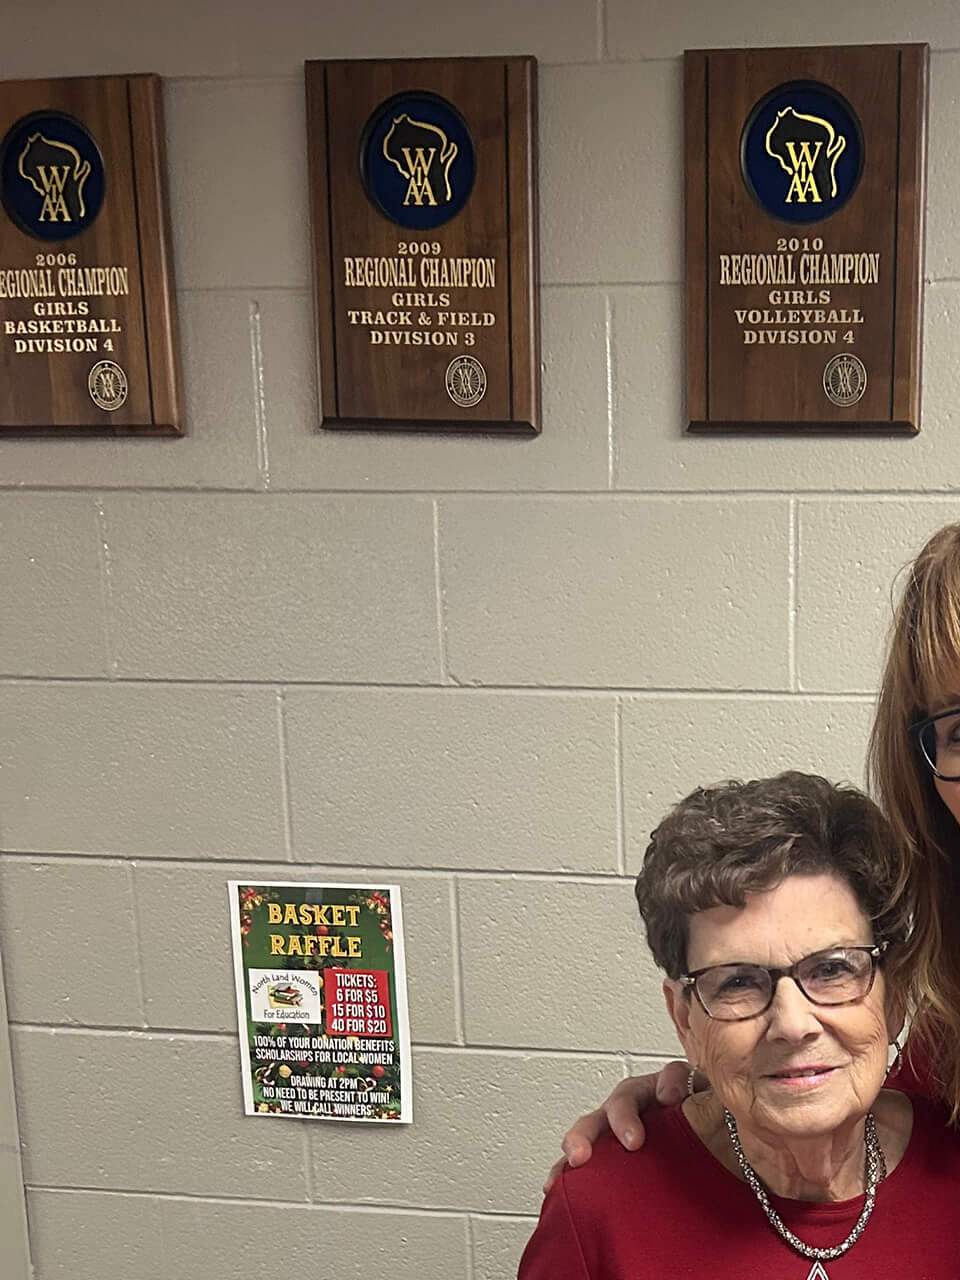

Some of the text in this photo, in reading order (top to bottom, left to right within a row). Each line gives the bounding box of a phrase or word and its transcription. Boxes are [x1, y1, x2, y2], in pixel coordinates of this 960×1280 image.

[398, 242, 441, 255] 2009
[777, 238, 824, 251] 2010
[36, 253, 77, 267] 2006
[344, 257, 496, 288] REGIONAL CHAMPION
[719, 253, 880, 285] REGIONAL CHAMPION
[0, 267, 129, 298] EGIONAL CHAMPION
[392, 293, 450, 307] GIRLS
[768, 290, 831, 305] GIRLS
[33, 301, 89, 316] GIRLS
[348, 311, 496, 326] TRACK & FIELD
[734, 309, 864, 324] VOLLEYBALL
[5, 319, 121, 334] BASKETBALL
[371, 331, 476, 346] DIVISION 3
[744, 330, 855, 345] DIVISION 4
[15, 338, 114, 353] DIVISION 4
[268, 903, 361, 927] BASKET
[270, 935, 362, 958] RAFFLE
[252, 973, 318, 996] North Land Women
[335, 974, 377, 988] TICKETS:
[336, 988, 378, 1003] 6 FOR $5
[264, 1009, 310, 1019] For Education
[332, 1004, 385, 1018] 15 FOR $10
[331, 1018, 387, 1033] 40 FOR $20
[253, 1036, 394, 1052] 100% OF YOUR DONATION BENEFITS
[256, 1049, 393, 1065] SCHOLARSHIPS FOR LOCAL WOMEN
[290, 1075, 358, 1089] DRAWING AT 2PM
[263, 1087, 390, 1104] NO NEED TO BE PRESENT TO WIN!
[280, 1101, 293, 1112] WE
[294, 1102, 313, 1113] WILL
[314, 1103, 333, 1114] CALL
